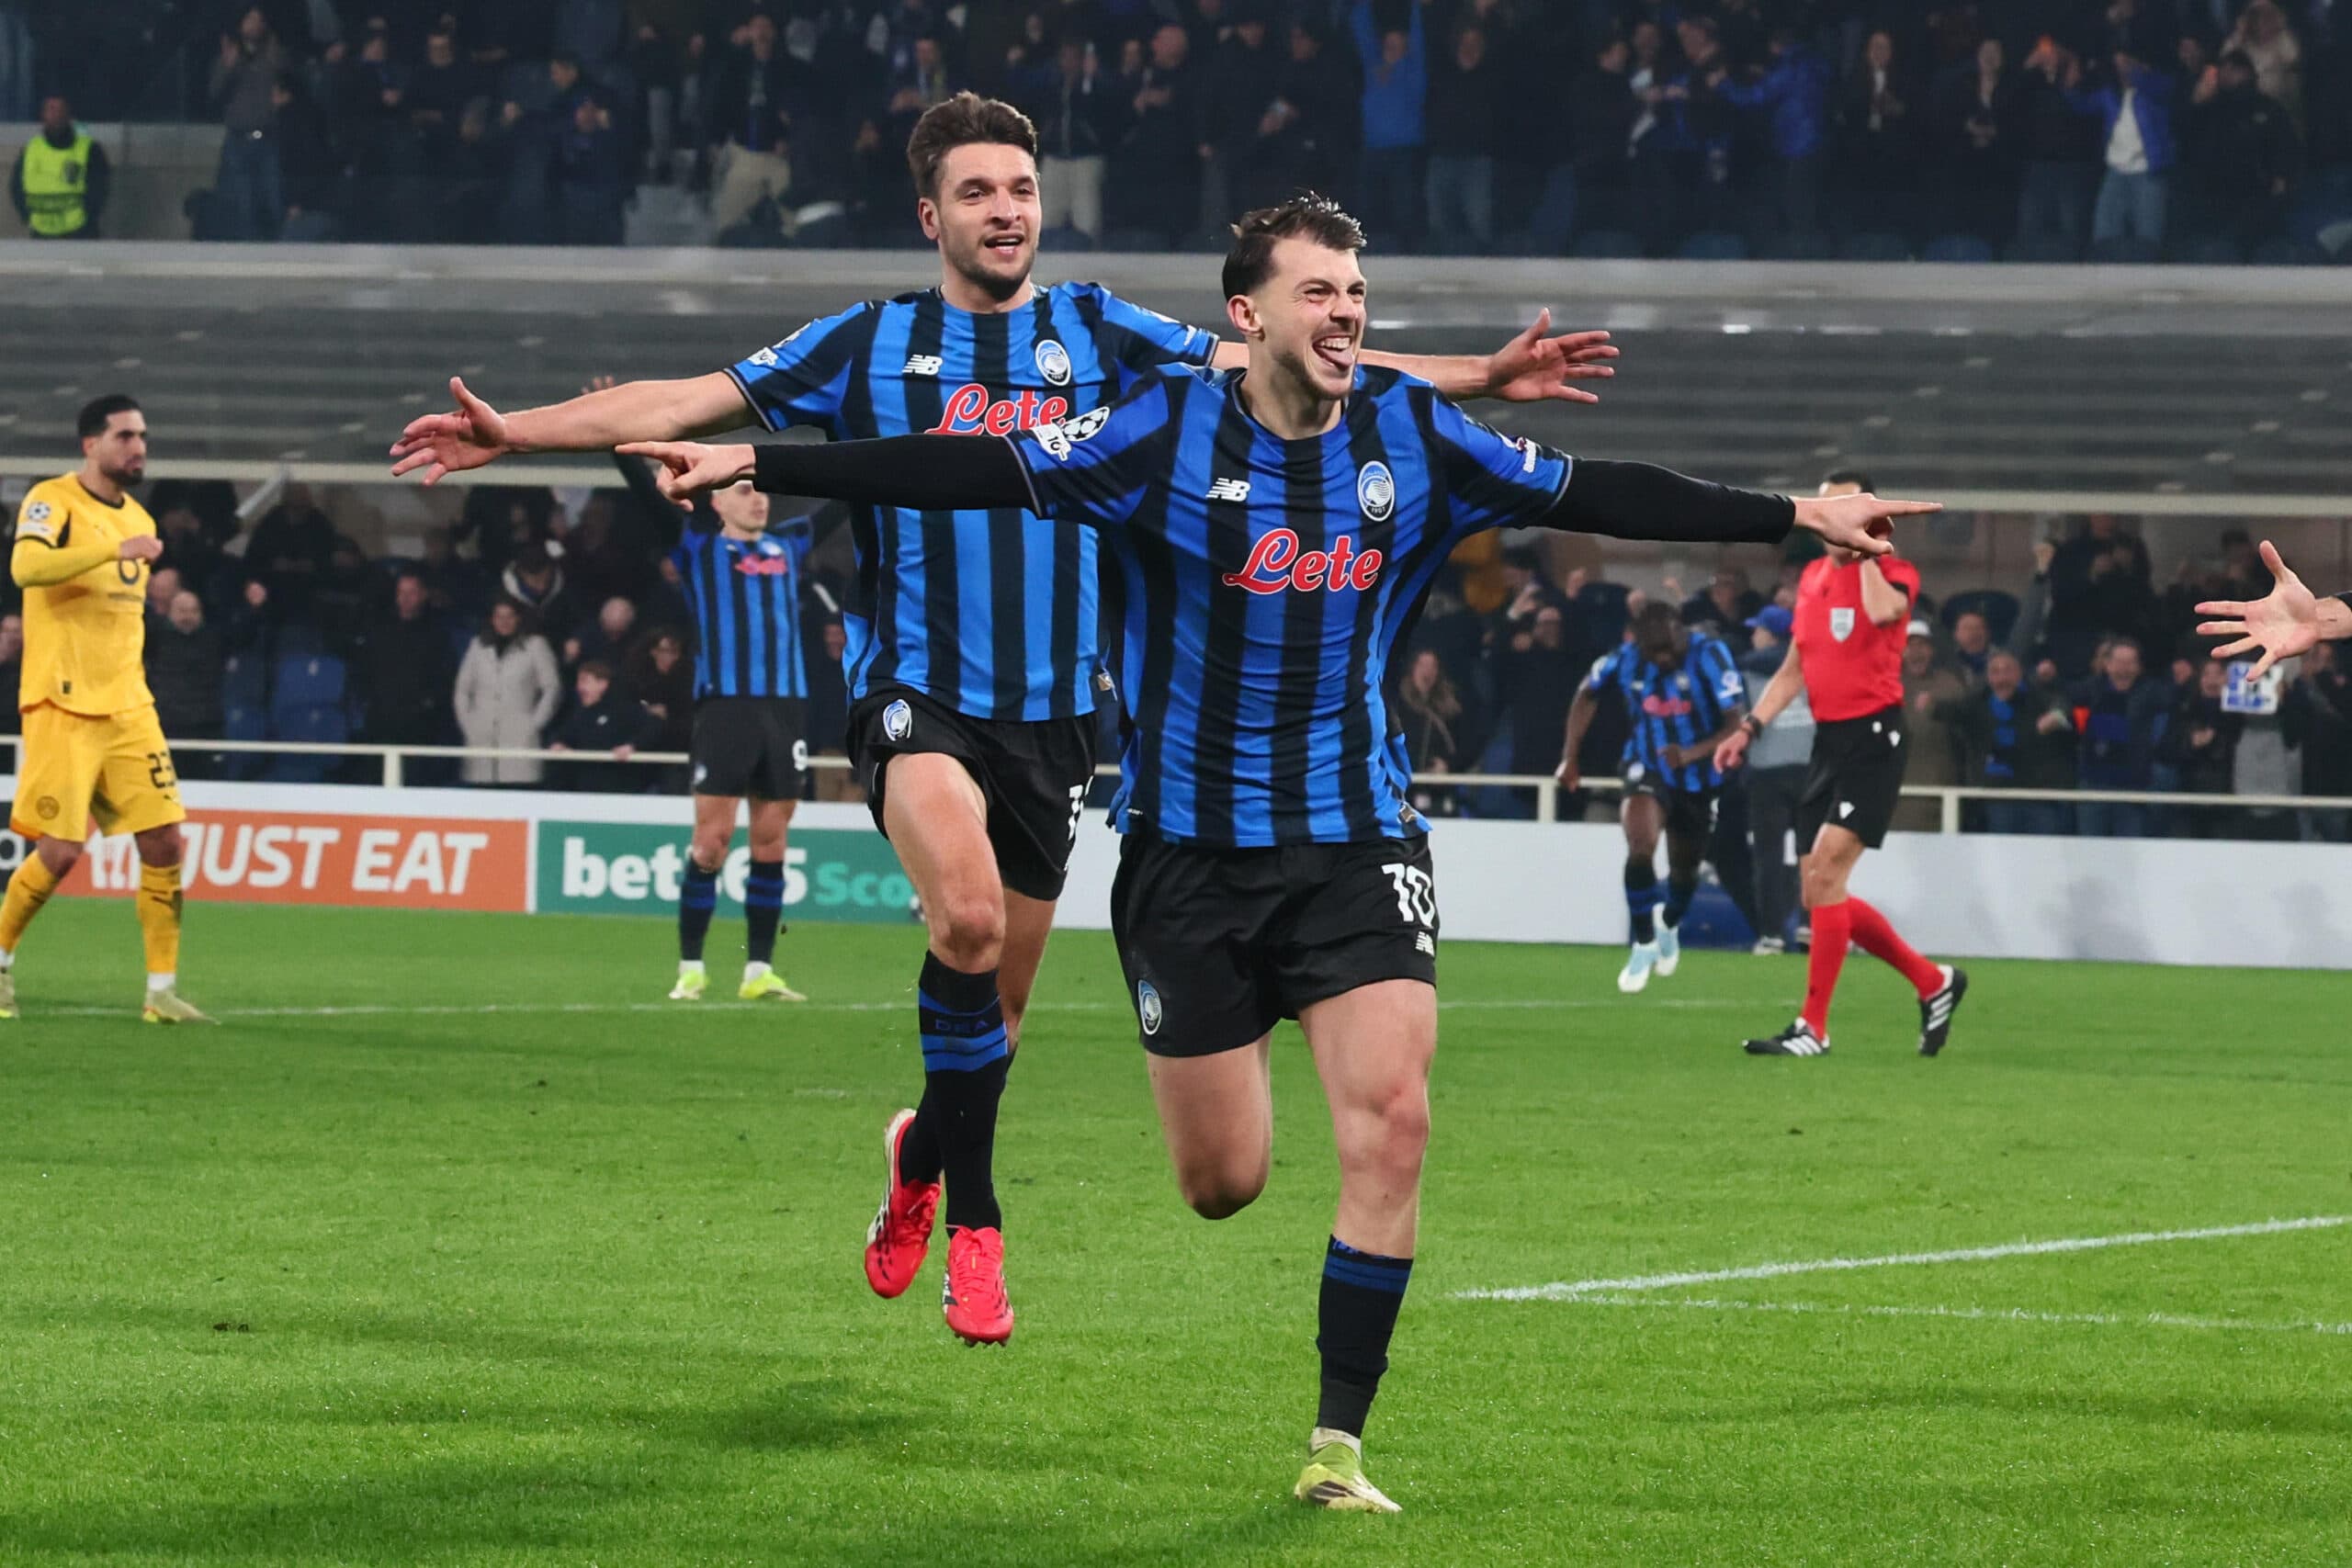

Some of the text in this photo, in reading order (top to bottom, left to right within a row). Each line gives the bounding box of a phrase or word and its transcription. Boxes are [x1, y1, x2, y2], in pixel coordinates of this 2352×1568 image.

[923, 383, 1068, 435] Lete
[1222, 528, 1383, 594] Lete
[179, 822, 489, 894] JUST EAT
[562, 837, 808, 905] bet65
[1381, 863, 1435, 929] 10
